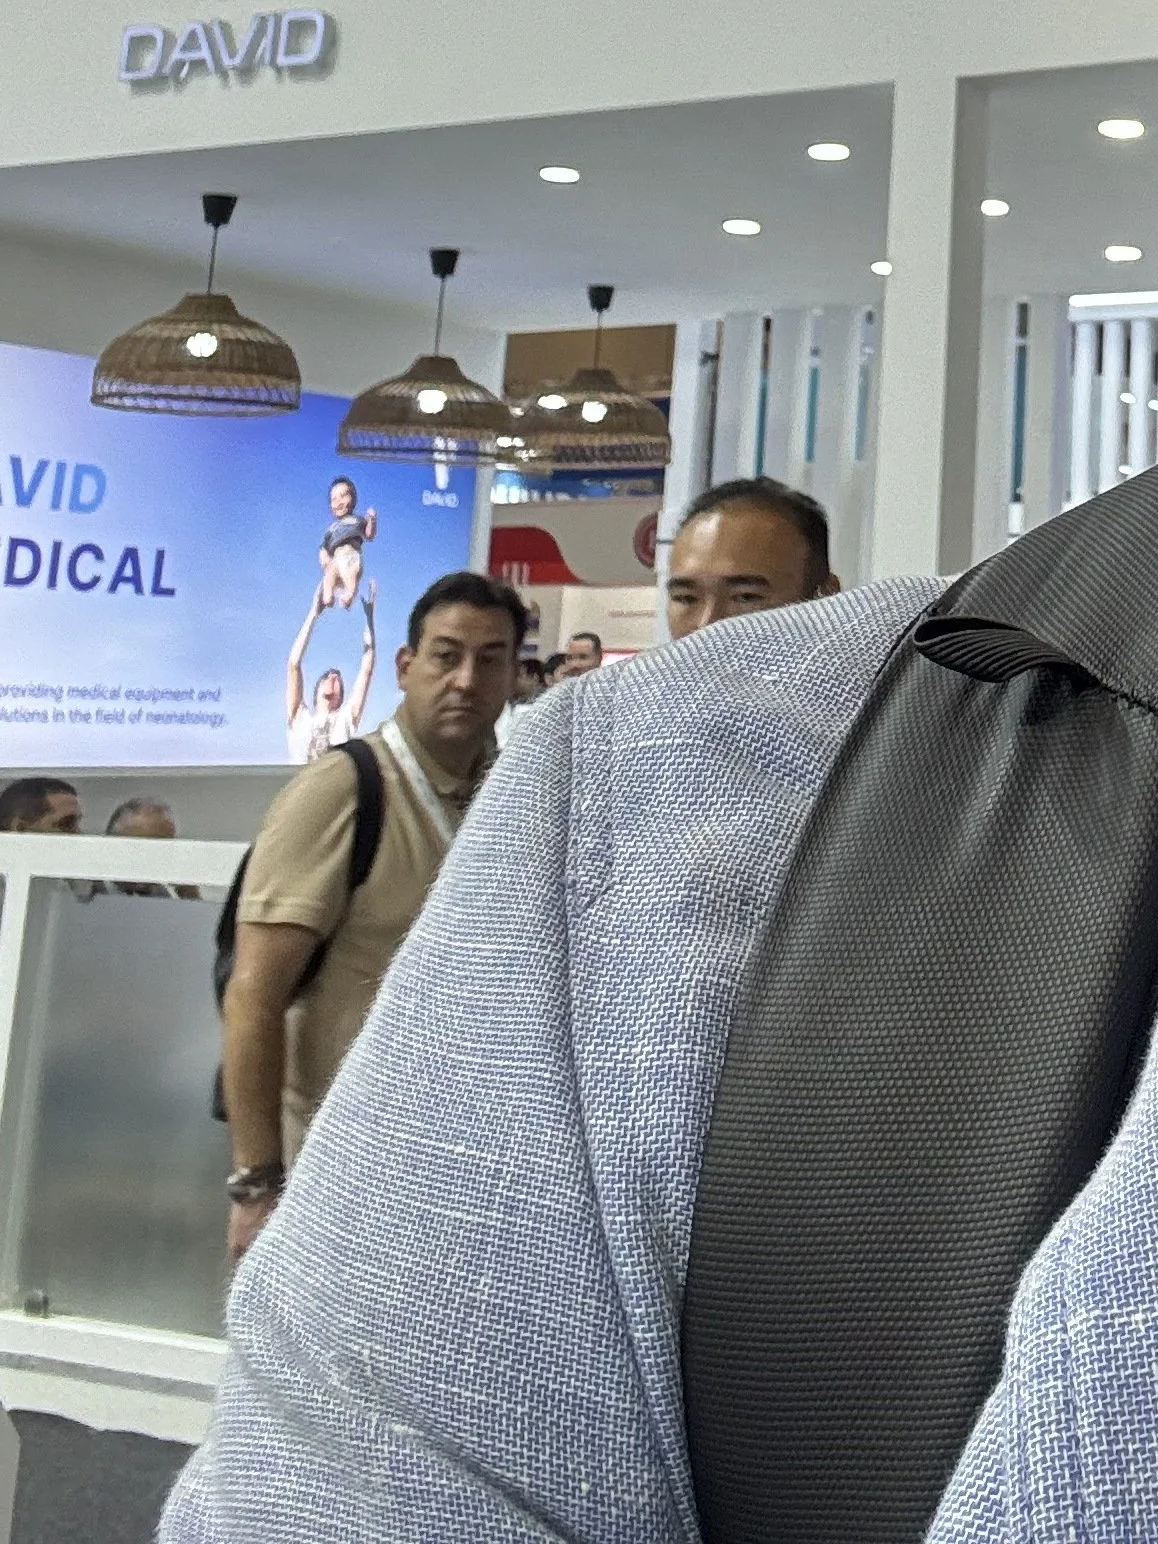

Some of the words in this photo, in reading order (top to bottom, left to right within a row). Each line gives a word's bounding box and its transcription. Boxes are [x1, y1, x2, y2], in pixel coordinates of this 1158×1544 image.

[118, 8, 326, 82] DAVID
[0, 455, 107, 514] VID
[0, 535, 176, 597] DICAL
[68, 708, 91, 723] the
[127, 707, 143, 724] of
